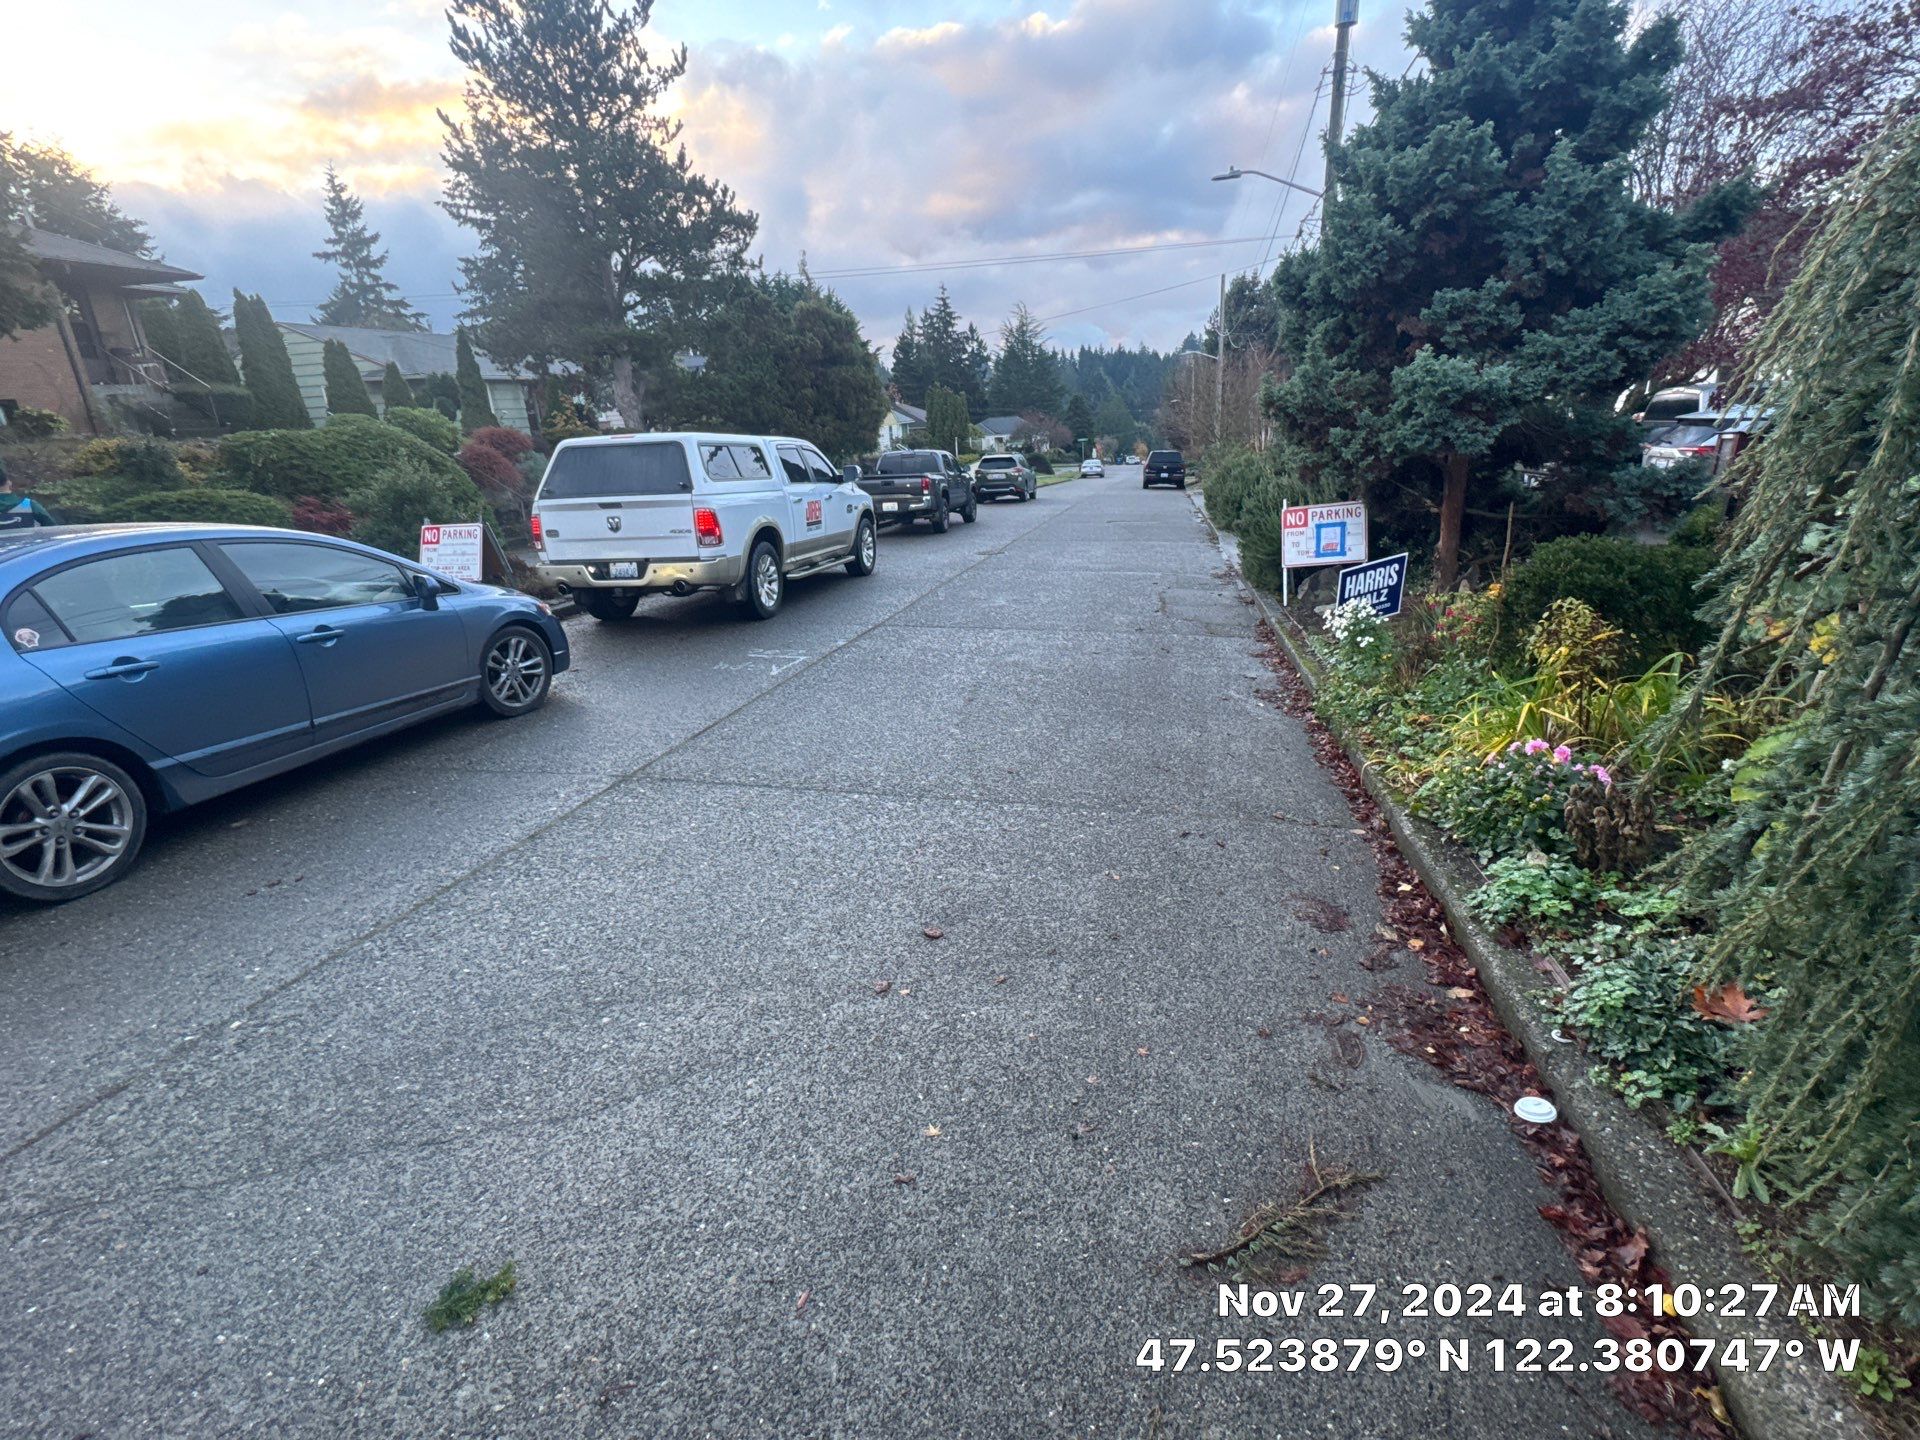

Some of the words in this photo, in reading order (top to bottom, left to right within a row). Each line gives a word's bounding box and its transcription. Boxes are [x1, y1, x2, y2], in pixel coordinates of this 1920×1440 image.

[1286, 511, 1305, 526] NO
[1311, 506, 1362, 521] PARKING
[424, 529, 438, 543] NO
[442, 528, 478, 539] PARKING
[1344, 563, 1400, 599] HARRIS
[1353, 588, 1389, 607] ALZ
